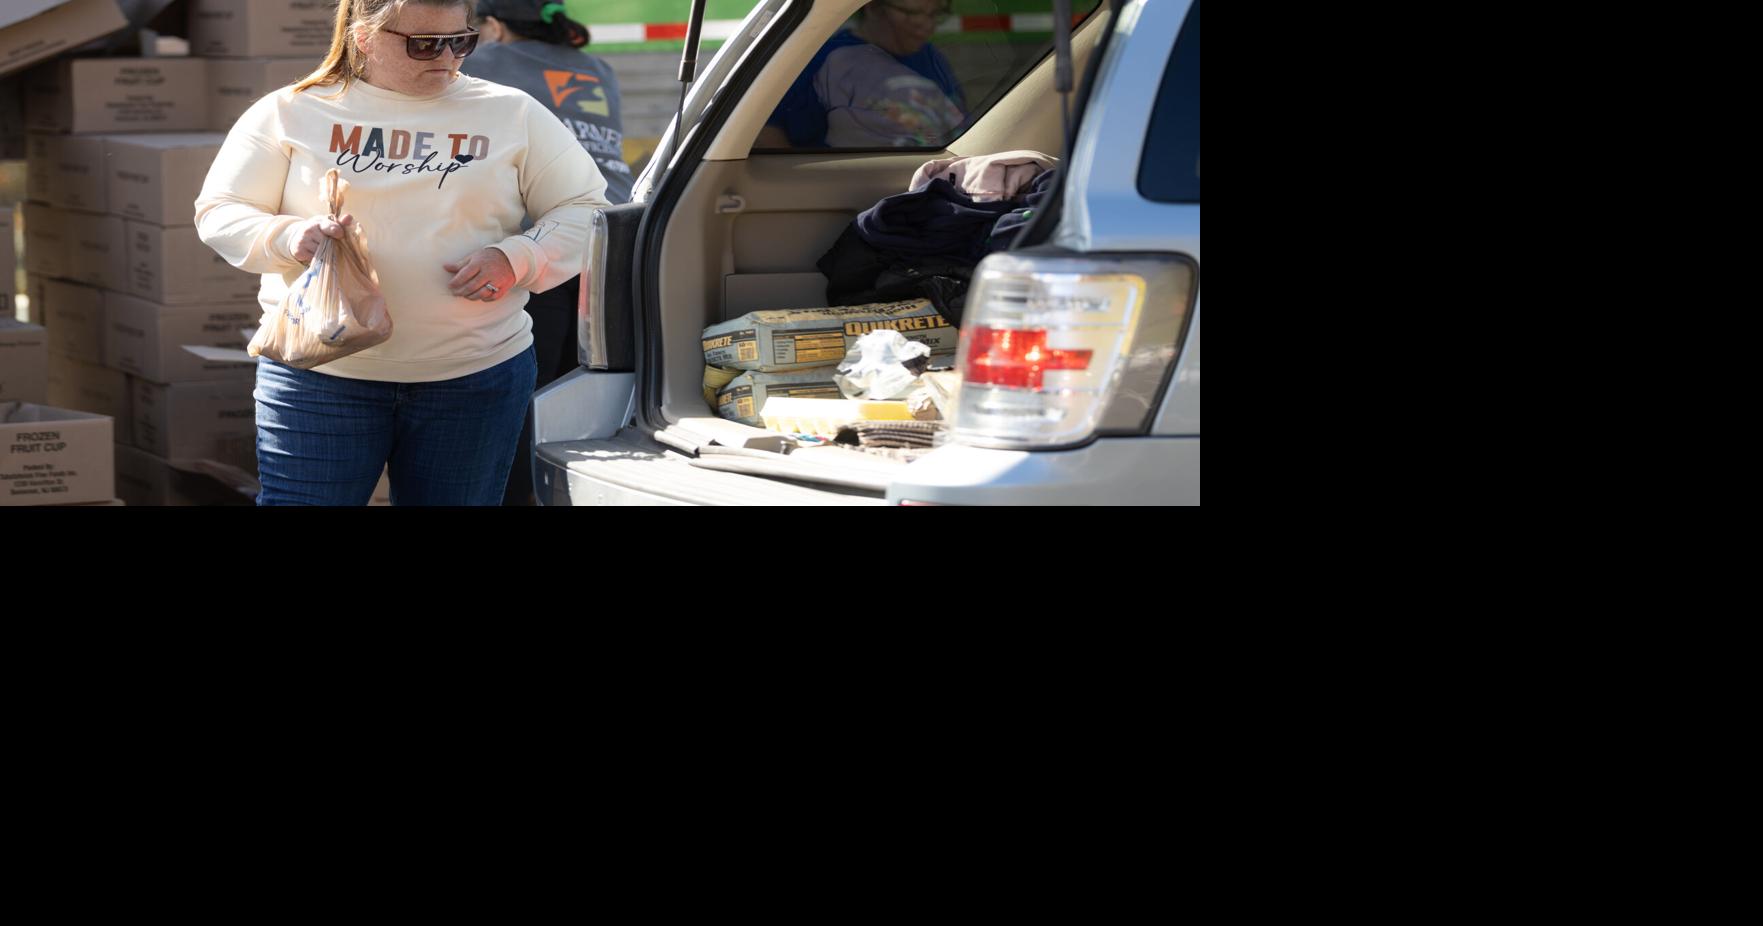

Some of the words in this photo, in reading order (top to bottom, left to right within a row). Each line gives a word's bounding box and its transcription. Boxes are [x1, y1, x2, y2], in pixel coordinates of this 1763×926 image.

[328, 124, 434, 160] MADE
[448, 134, 490, 161] TO
[336, 148, 468, 190] Worship
[844, 314, 950, 336] QUIKRETE
[10, 443, 41, 454] FRUIT
[43, 442, 67, 452] CUP
[16, 431, 60, 442] FROZEN
